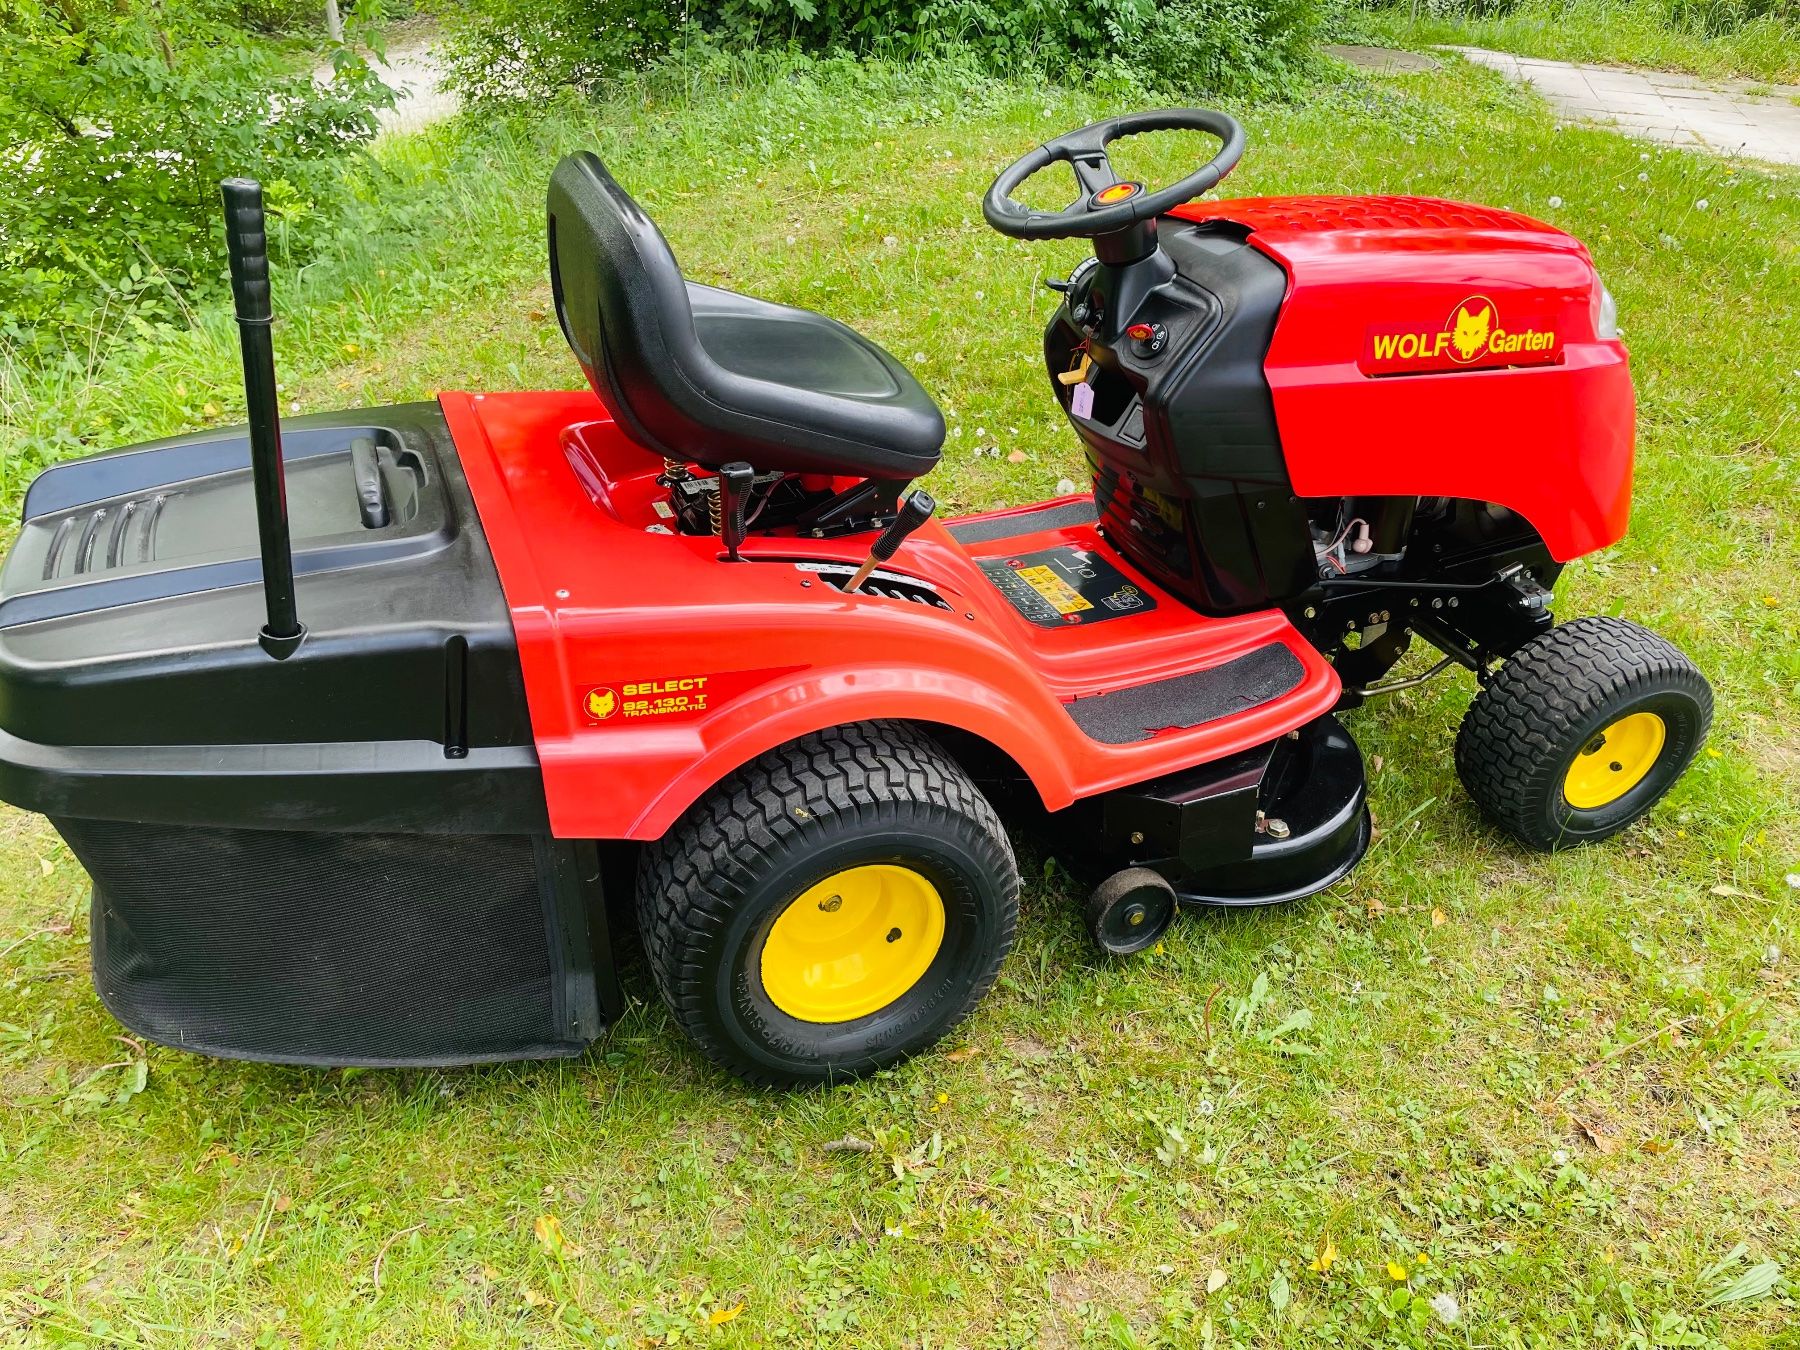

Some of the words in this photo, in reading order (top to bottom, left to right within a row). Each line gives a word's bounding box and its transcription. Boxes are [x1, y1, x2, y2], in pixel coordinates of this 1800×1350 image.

[1374, 332, 1451, 360] WOLF
[1489, 328, 1555, 354] Garten
[623, 677, 707, 696] SELECT
[623, 696, 688, 711] 92.130
[695, 694, 707, 704] T
[623, 703, 707, 718] TRANSMATIC
